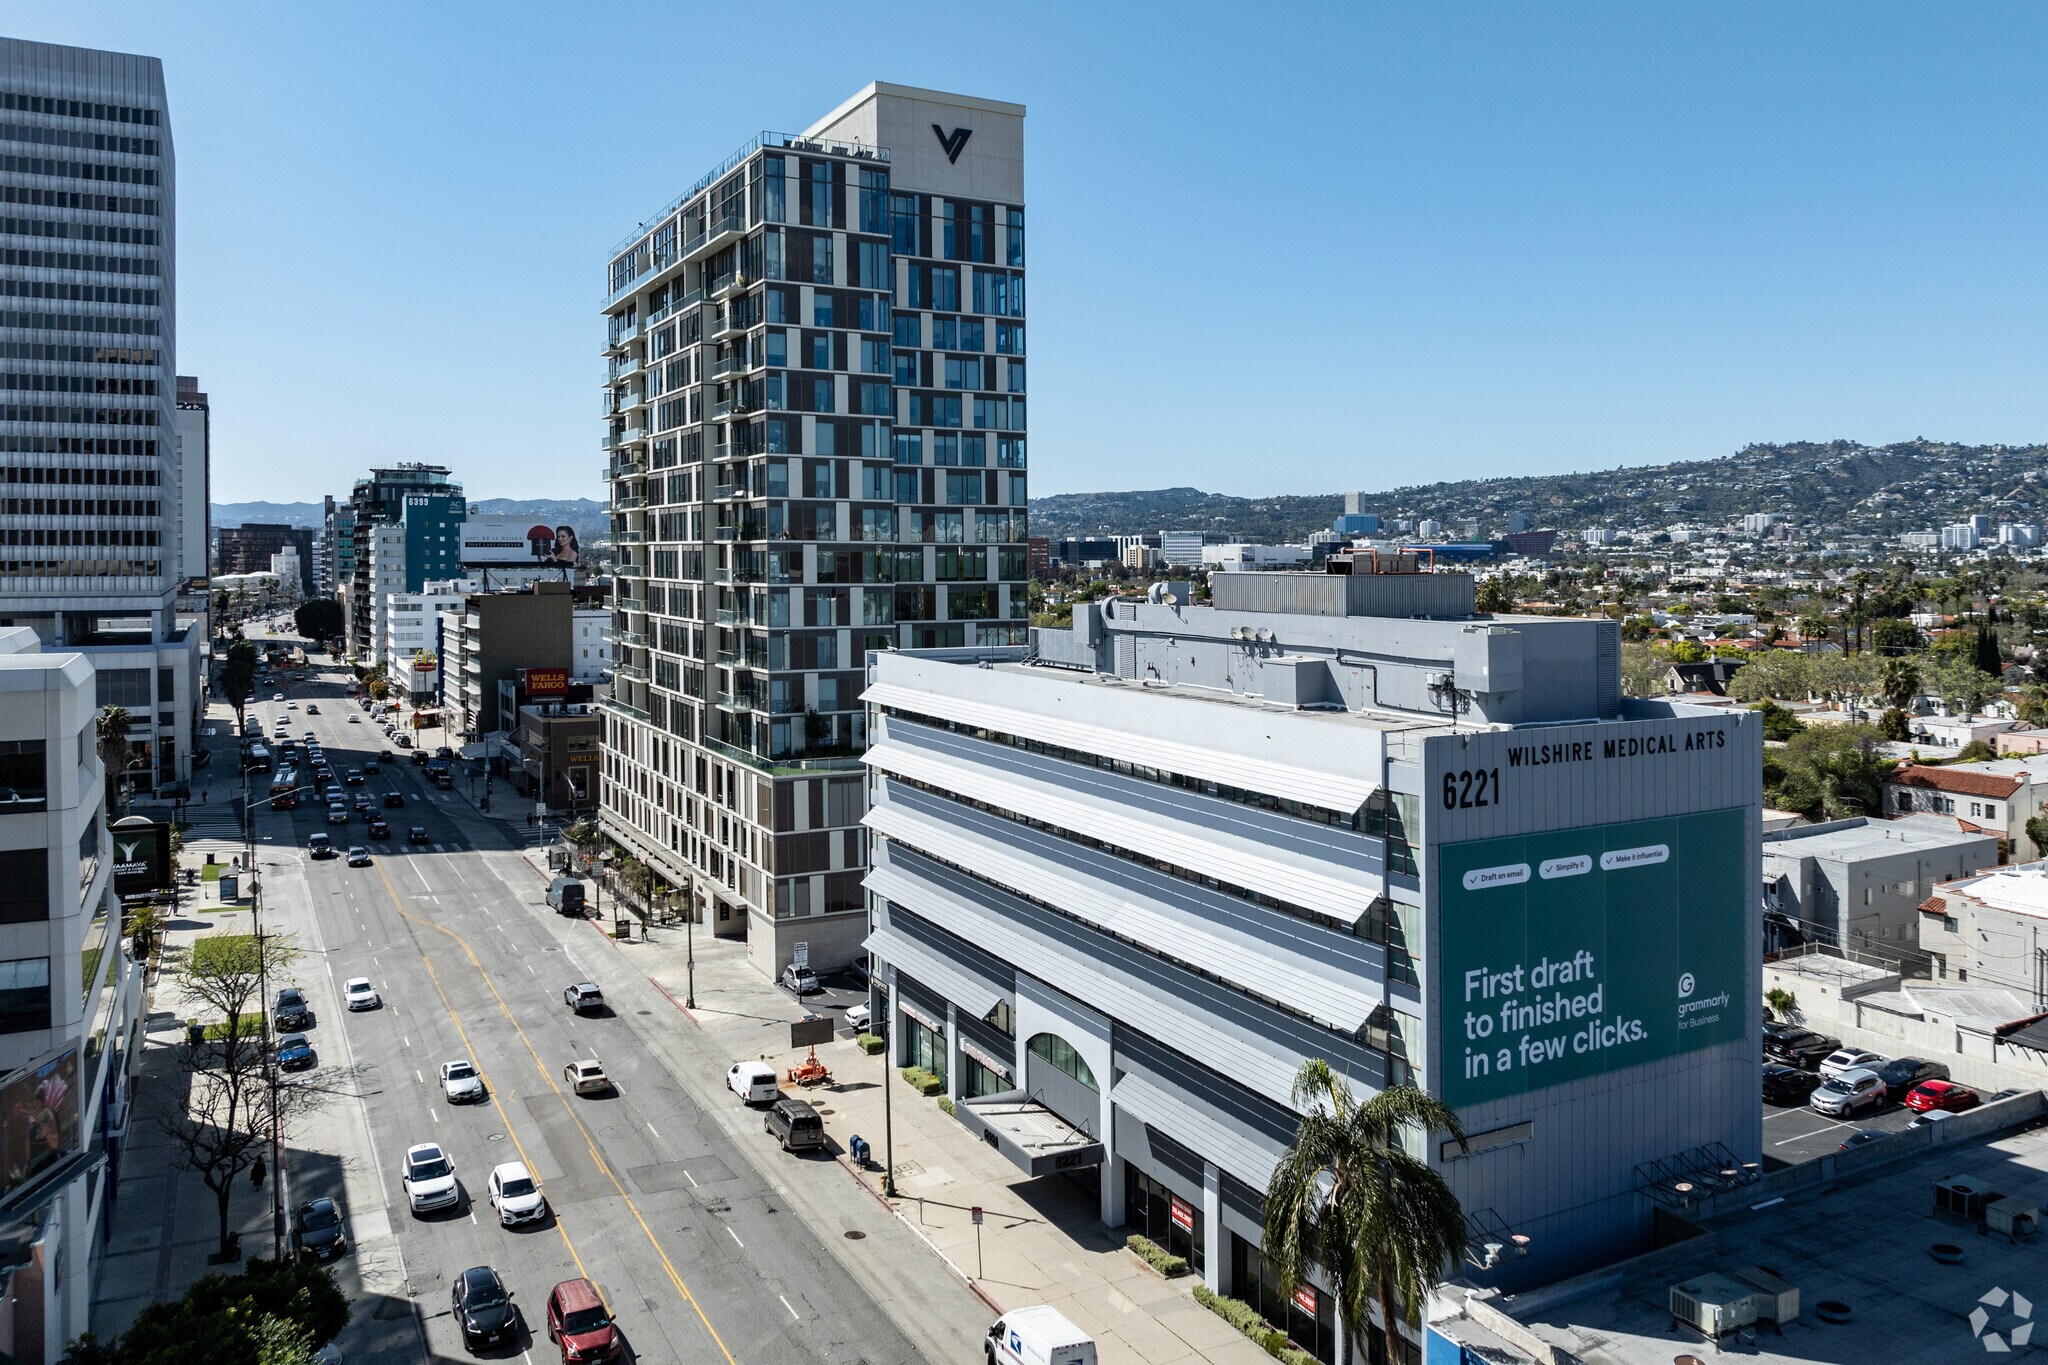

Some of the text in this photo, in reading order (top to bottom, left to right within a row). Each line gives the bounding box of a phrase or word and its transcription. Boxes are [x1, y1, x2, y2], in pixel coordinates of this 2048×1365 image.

[409, 497, 429, 506] 6399
[531, 674, 565, 682] WELLS
[532, 681, 565, 689] FARGO
[1508, 730, 1725, 767] WILSHIRE MEDICAL ARTS
[570, 754, 599, 762] WELLS
[1443, 767, 1499, 810] 6221
[1615, 855, 1631, 863] Make
[1636, 850, 1663, 860] influential
[1555, 862, 1579, 872] Simplify
[1481, 873, 1497, 882] Draft
[1506, 870, 1524, 879] email
[1465, 950, 1594, 1002] First draft
[1464, 983, 1603, 1040] to finished
[1678, 990, 1730, 1018] grammarly
[1678, 1014, 1720, 1030] for Business
[1465, 1015, 1648, 1079] in a few clicks.
[1055, 1152, 1082, 1170] 6221
